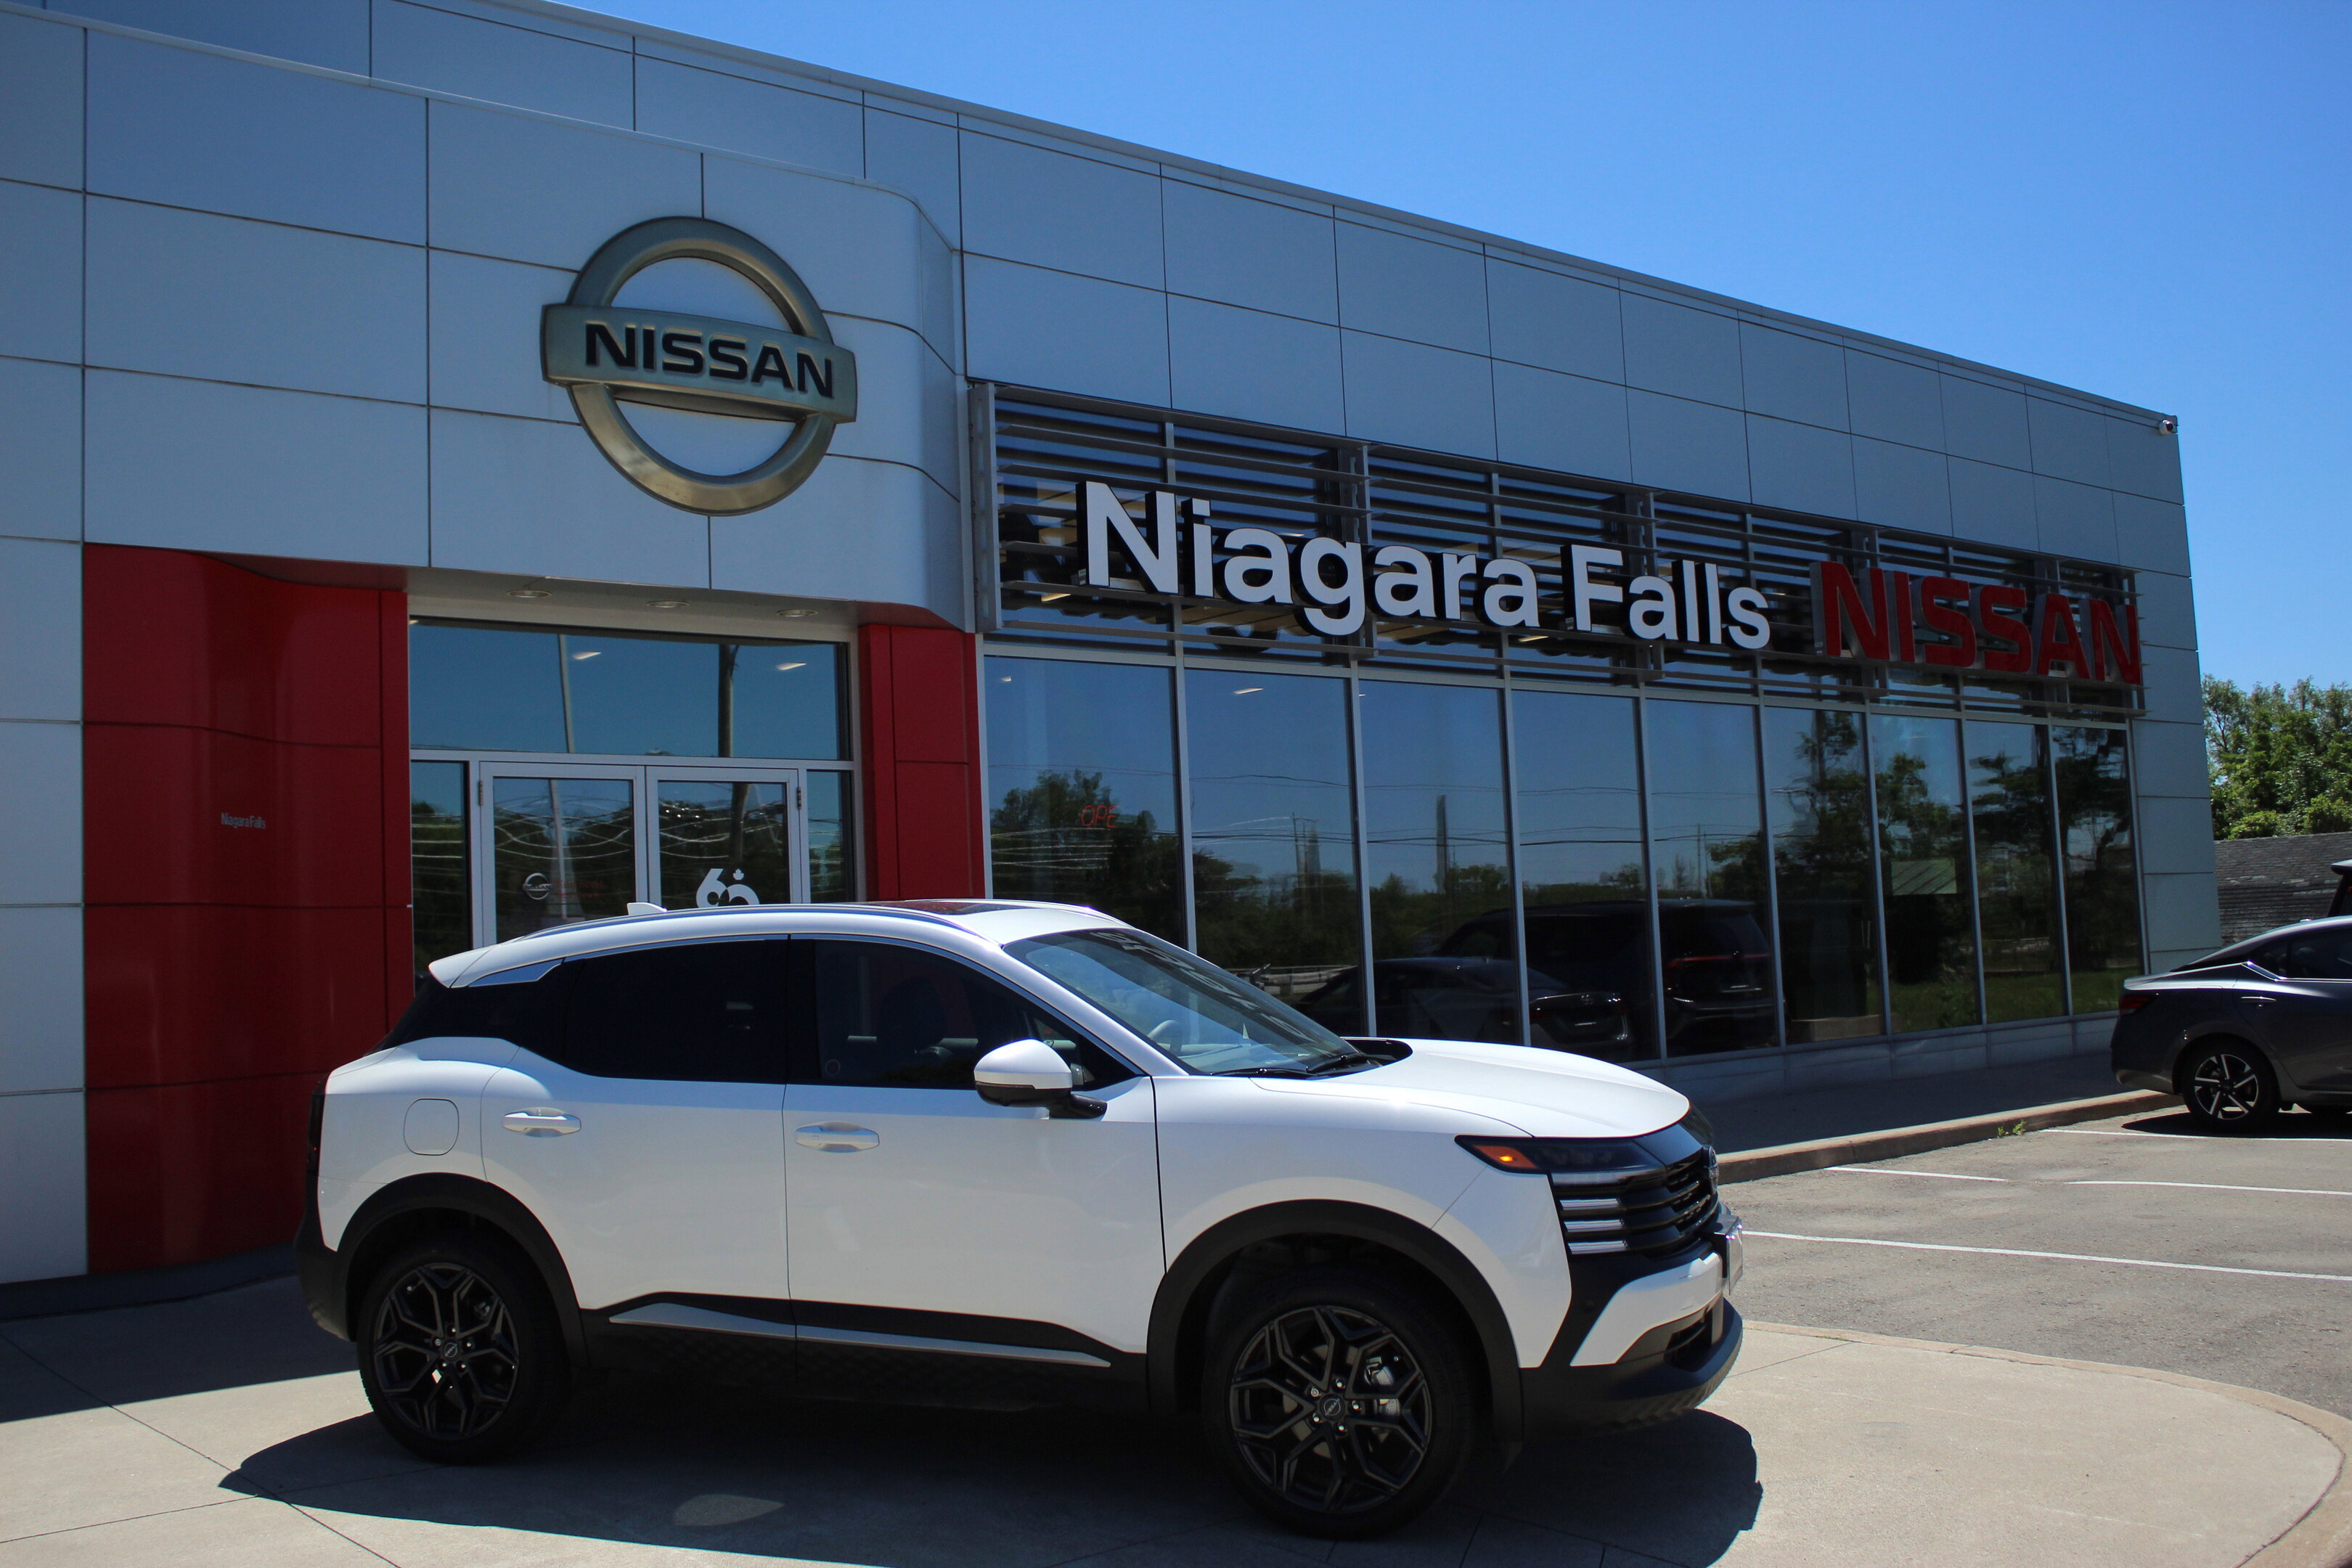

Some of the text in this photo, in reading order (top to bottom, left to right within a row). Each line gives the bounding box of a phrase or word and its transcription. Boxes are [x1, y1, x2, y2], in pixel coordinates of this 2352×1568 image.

[584, 321, 834, 399] NISSAN
[1082, 479, 2144, 686] Niagara Falls NISSAN
